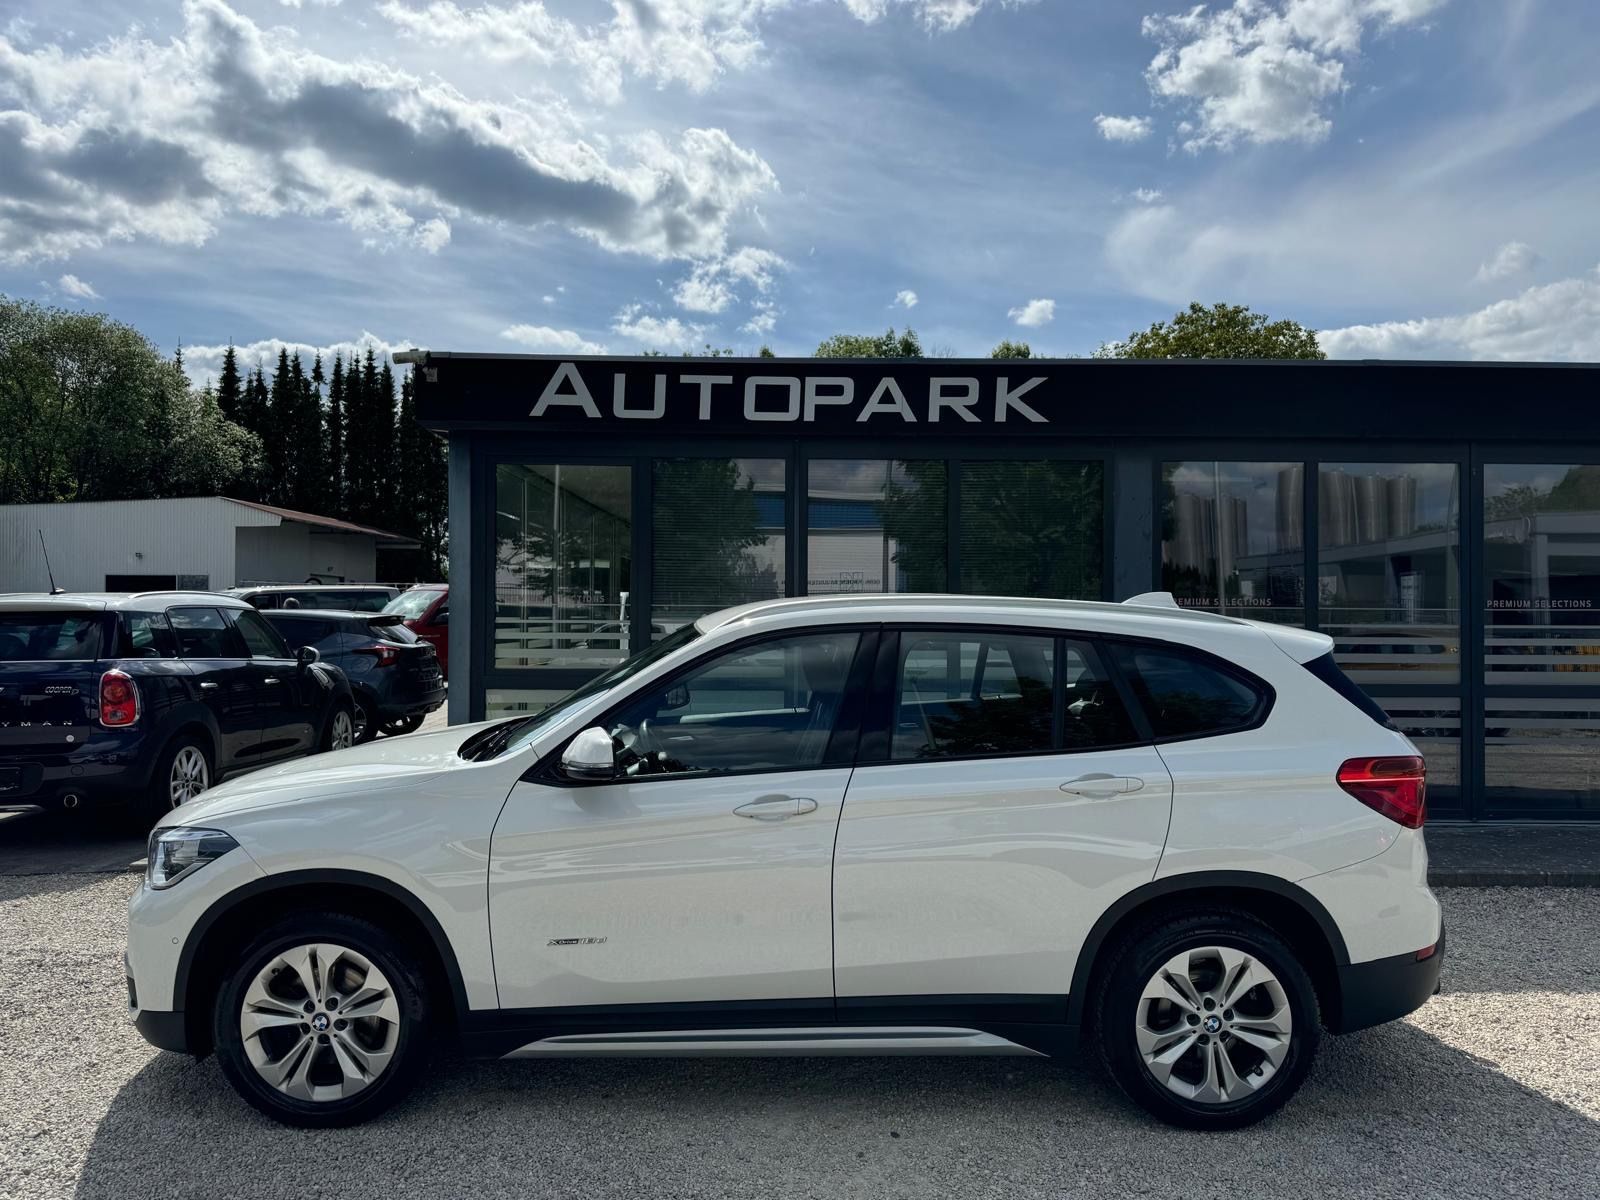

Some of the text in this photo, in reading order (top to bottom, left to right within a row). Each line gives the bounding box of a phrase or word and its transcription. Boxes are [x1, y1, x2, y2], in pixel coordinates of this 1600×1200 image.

[528, 362, 1050, 422] AUTOPARK
[1174, 598, 1272, 606] EMIUM SELECTIONS
[1487, 600, 1592, 608] PREMIUM SELECTIONS
[45, 686, 73, 694] COOPER
